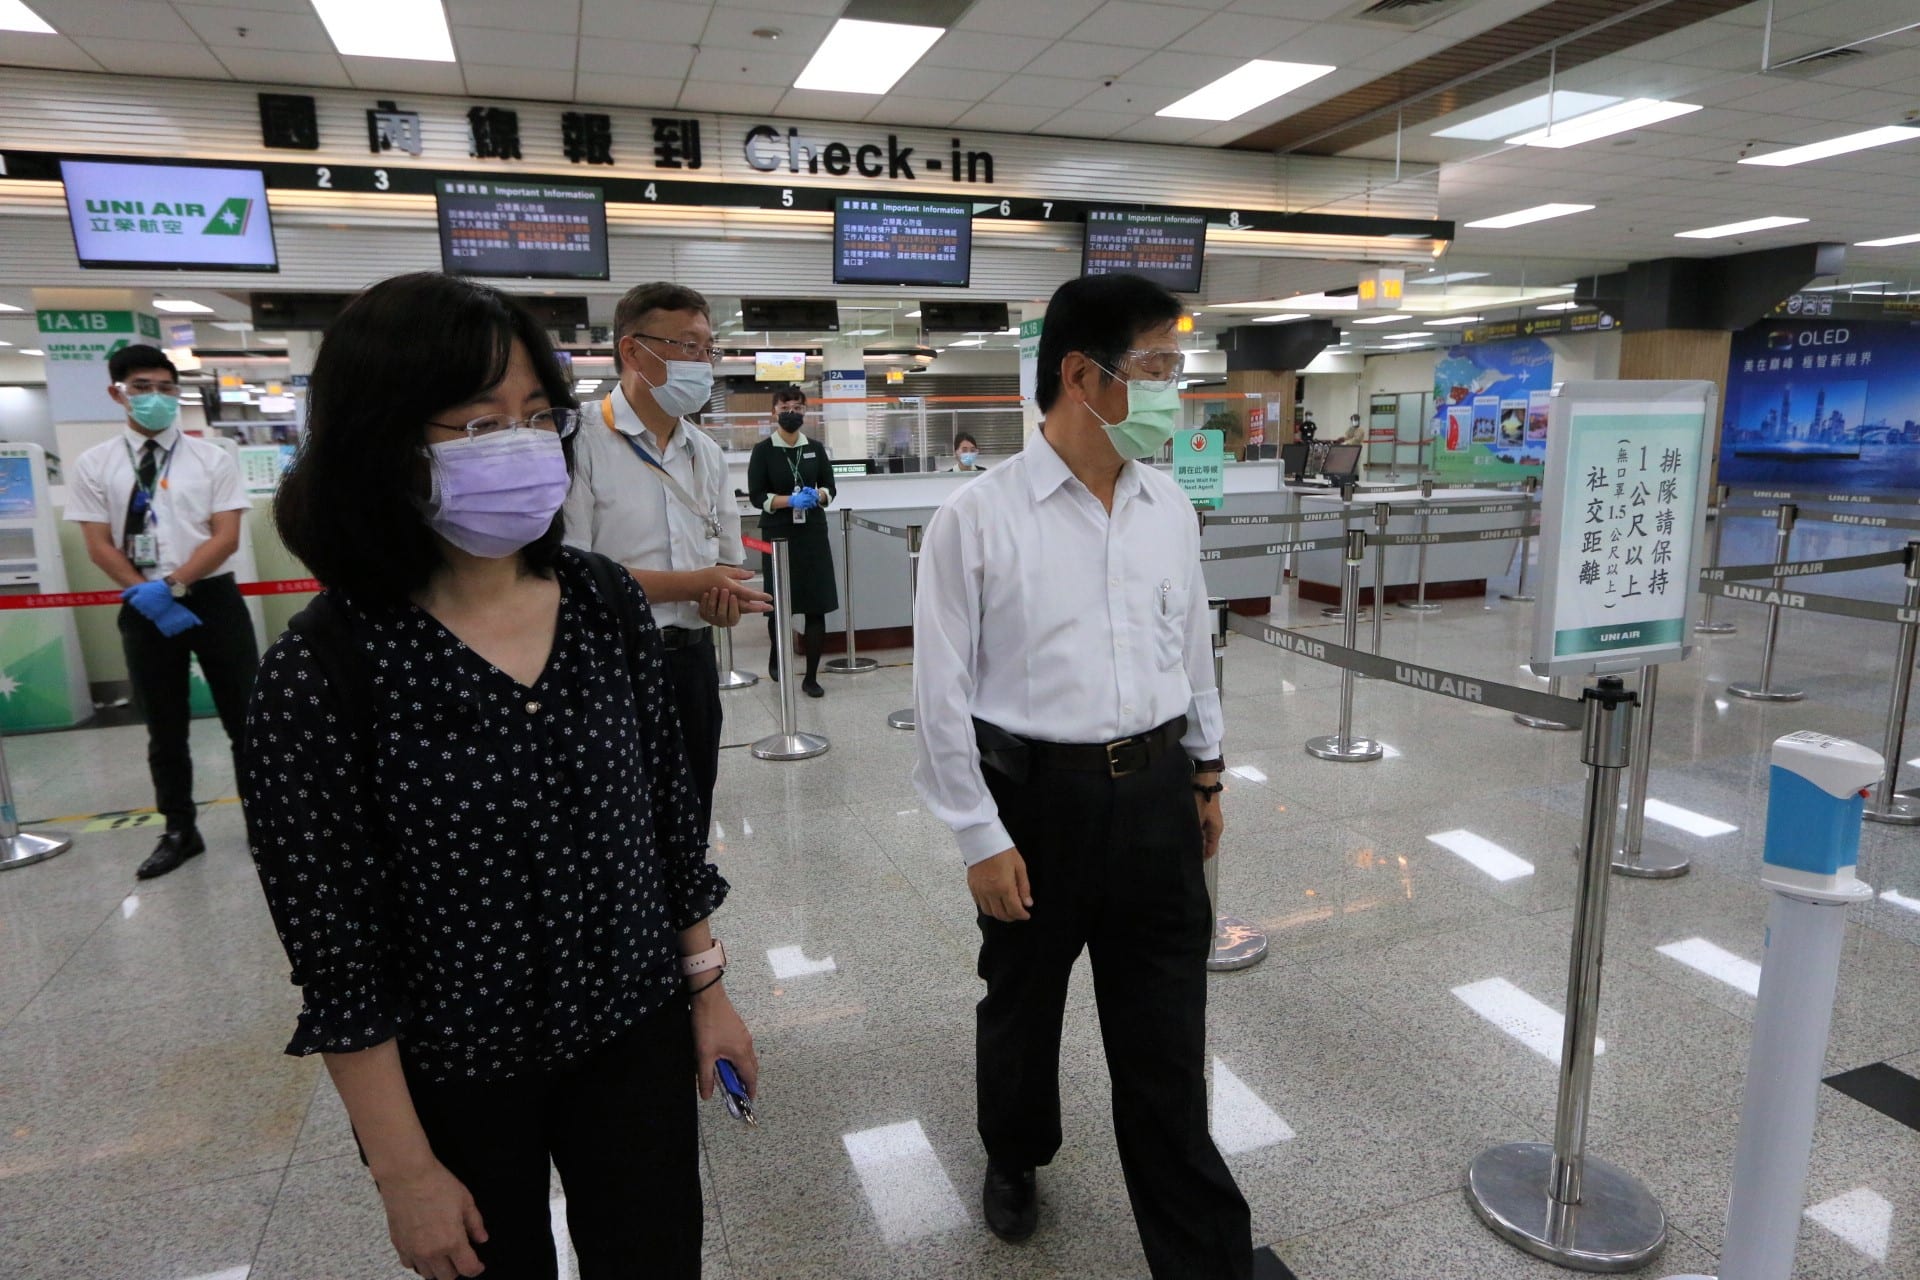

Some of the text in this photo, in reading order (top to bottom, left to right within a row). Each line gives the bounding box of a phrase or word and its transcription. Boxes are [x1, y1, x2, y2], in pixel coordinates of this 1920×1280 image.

[745, 125, 994, 183] Check-in
[317, 167, 332, 188] 2
[375, 170, 389, 190] 3
[495, 186, 540, 198] Important
[544, 188, 596, 199] Information
[645, 183, 657, 201] 4
[782, 189, 793, 207] 5
[86, 200, 206, 217] UNI AIR
[883, 203, 920, 214] Important
[923, 205, 965, 215] Information
[1001, 199, 1010, 216] 6
[1043, 202, 1053, 218] 7
[90, 218, 184, 234] 立榮航空
[1128, 213, 1161, 223] Important
[1164, 215, 1203, 224] Information
[1229, 212, 1239, 228] 8
[42, 313, 107, 330] 1A.1B
[1799, 328, 1849, 346] OLED
[831, 371, 843, 379] 2A
[1753, 491, 1791, 499] UNI AIR
[1828, 494, 1871, 503] UNI AIR
[1251, 516, 1269, 524] AIR
[1323, 512, 1340, 520] AIR
[1648, 448, 1682, 596] 排隊請保持
[1833, 514, 1887, 527] UNI AIR
[1480, 528, 1522, 539] UNI AIR
[1579, 466, 1609, 585] 社交距離
[1396, 534, 1440, 544] UNI AIR
[1266, 541, 1315, 554] UNI AIR
[1701, 569, 1725, 581] AIR
[1773, 562, 1824, 576] UNI AIR
[1724, 584, 1805, 608] UNI AIR
[1263, 628, 1325, 659] UNI AIR
[1601, 630, 1641, 642] UNI AIR
[1395, 665, 1483, 702] UNI AIR
